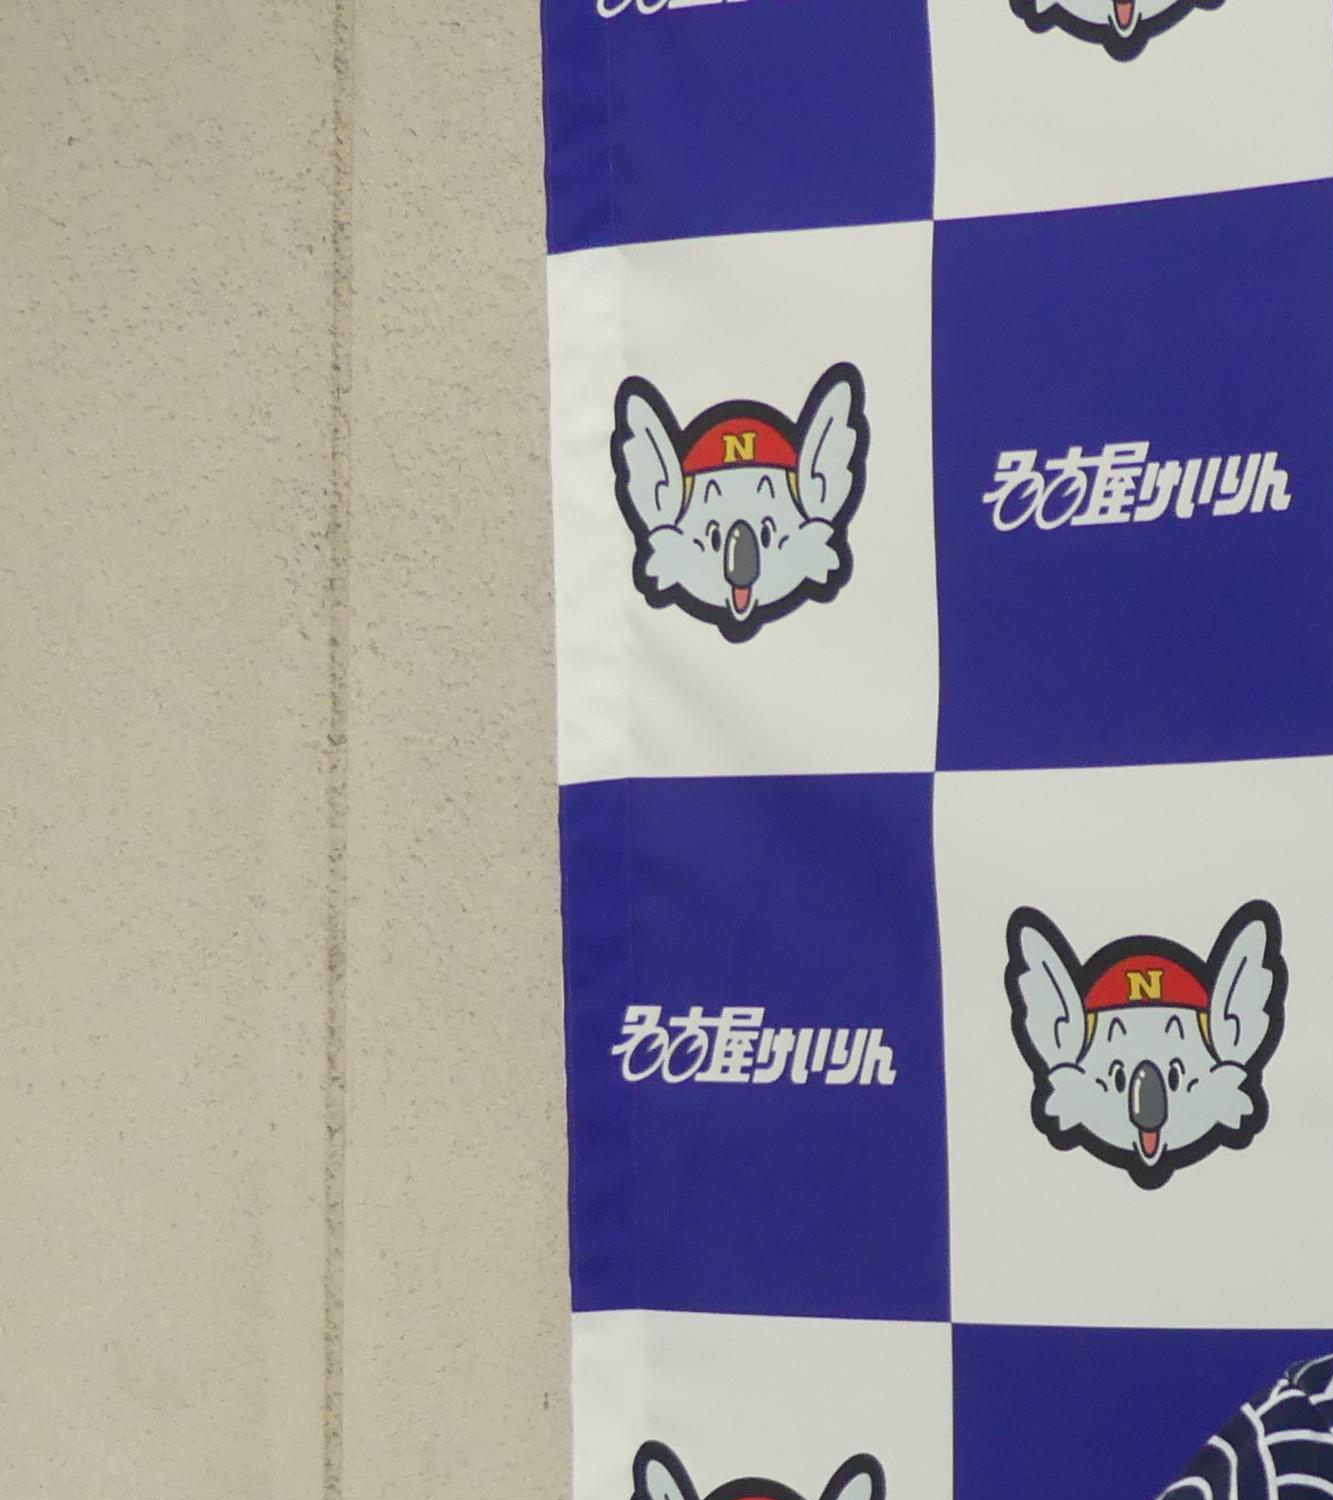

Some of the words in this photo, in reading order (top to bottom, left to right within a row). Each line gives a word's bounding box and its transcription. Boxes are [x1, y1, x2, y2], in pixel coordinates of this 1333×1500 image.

[723, 432, 755, 463] N
[982, 441, 1291, 531] 名古屋けいりん
[1126, 971, 1163, 1001] N
[611, 1005, 896, 1085] 名古屋けいりん
